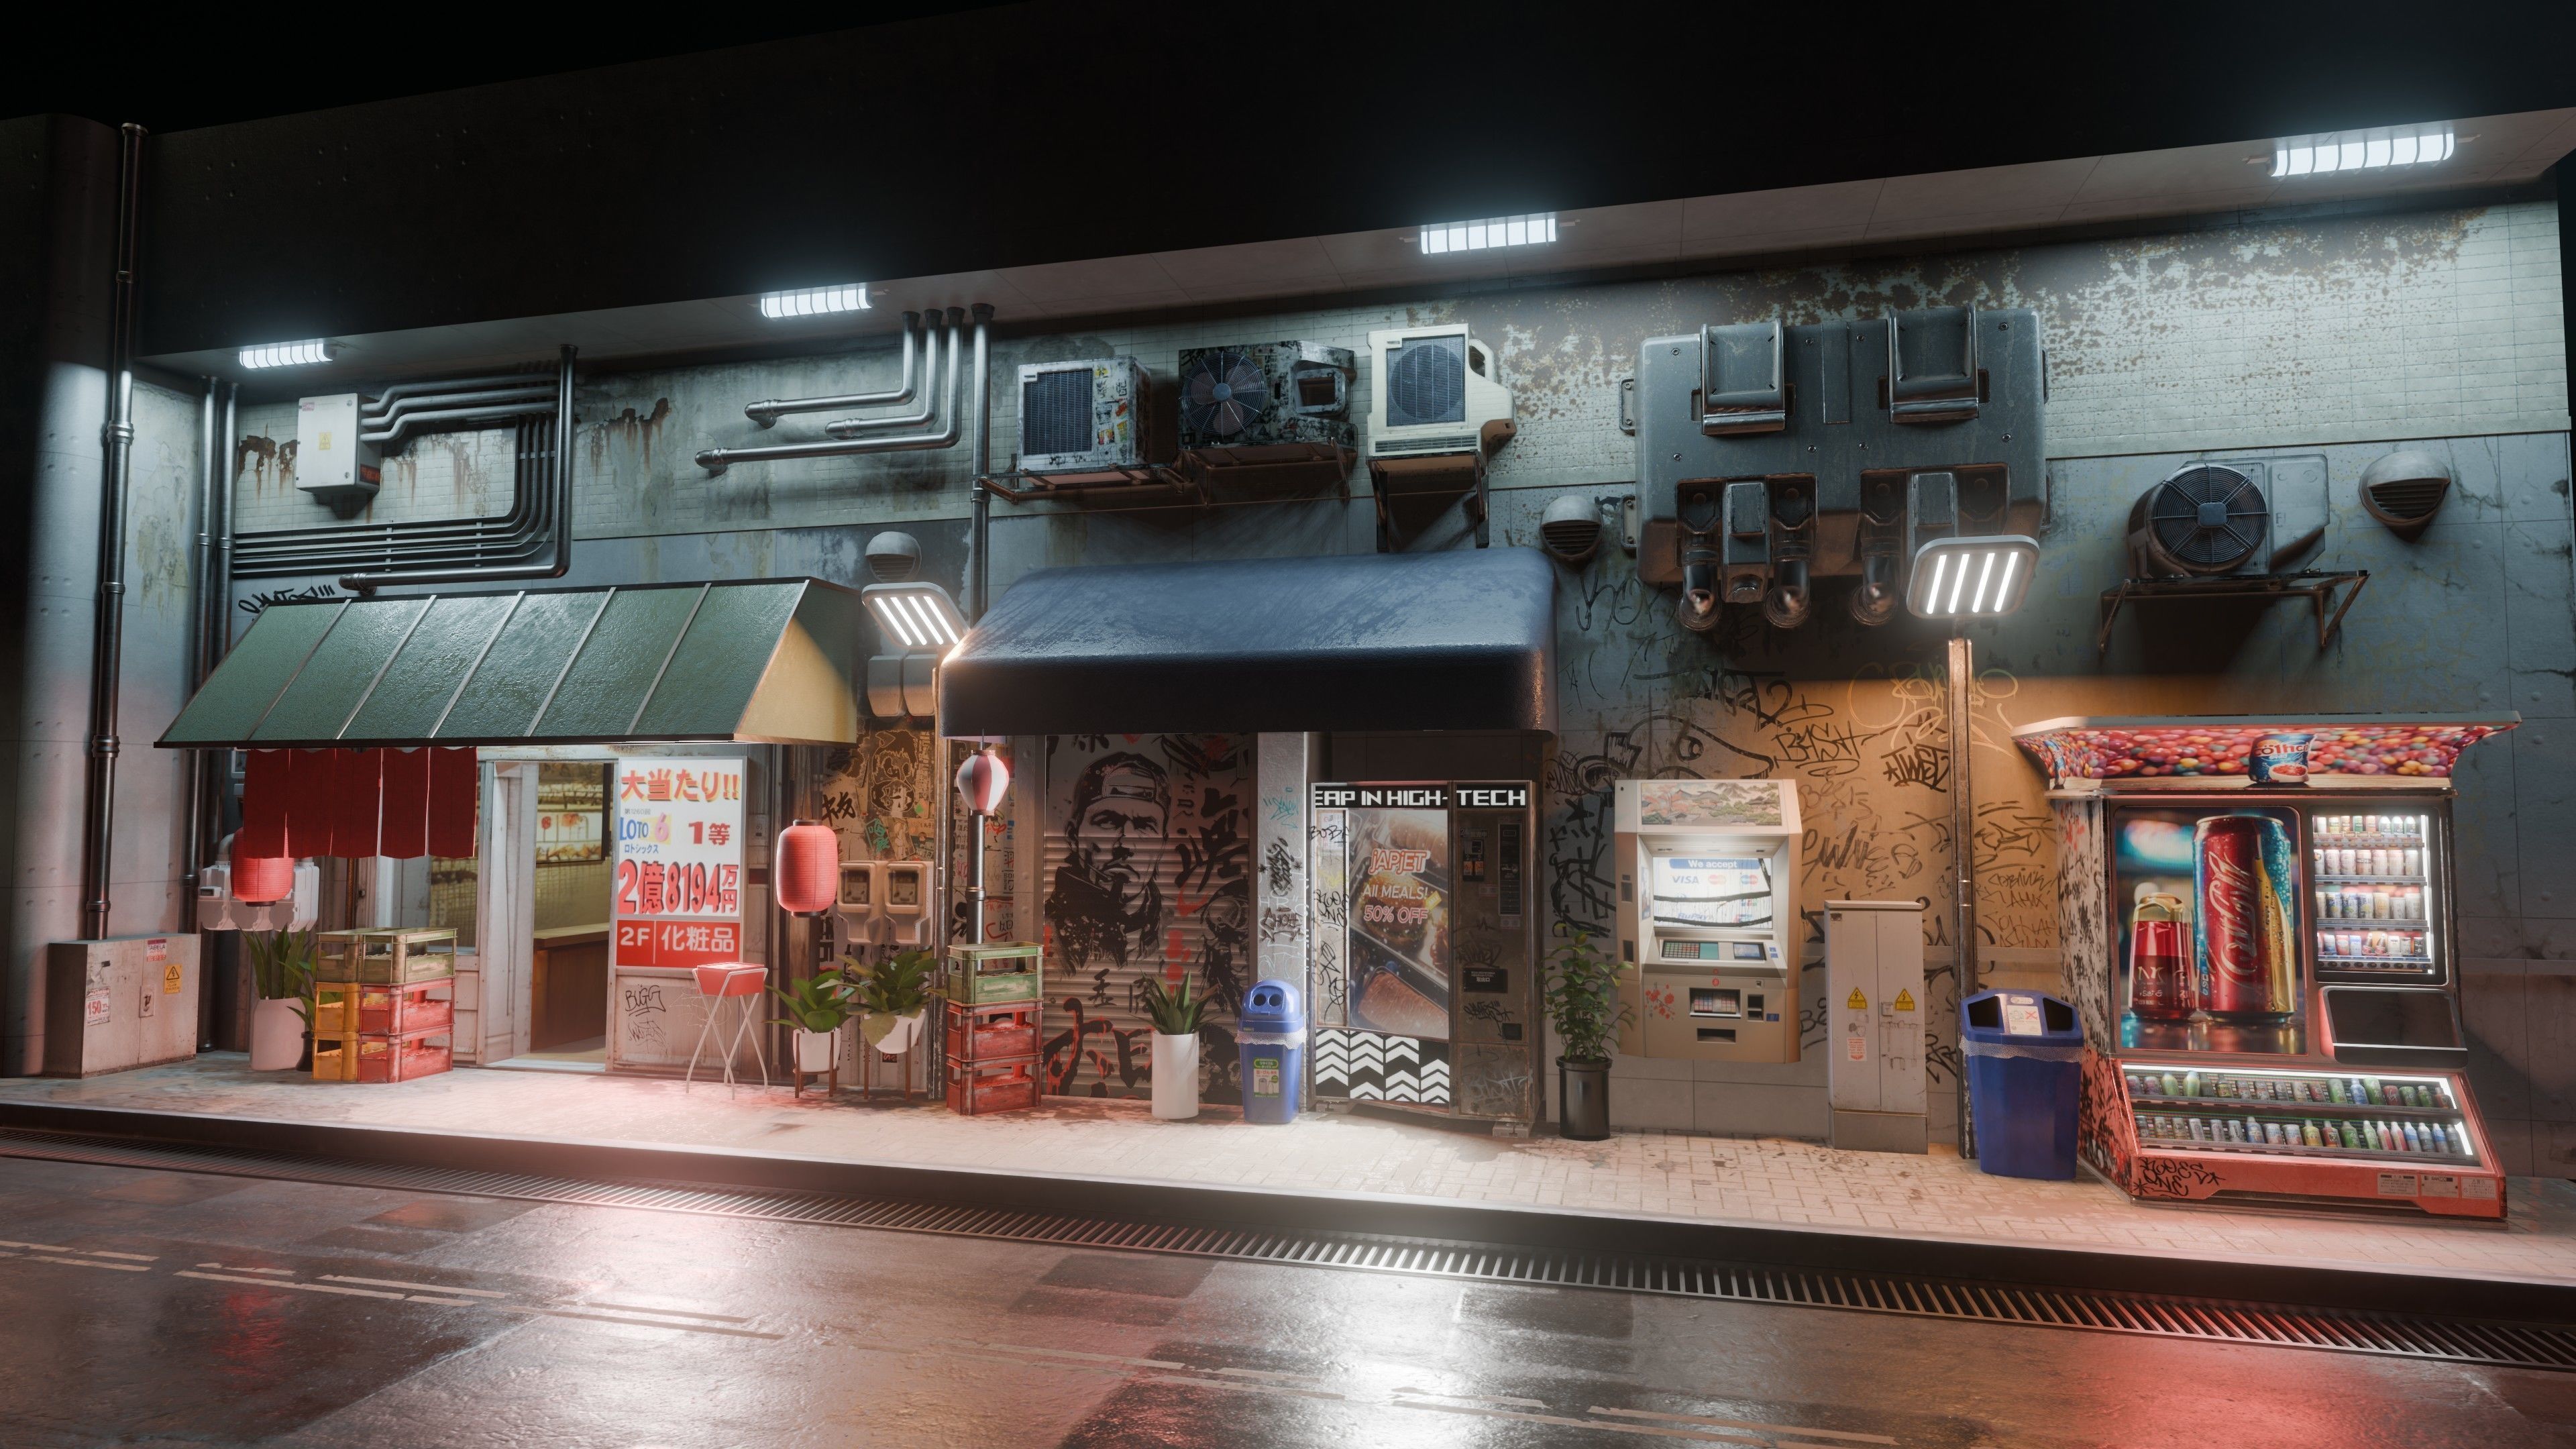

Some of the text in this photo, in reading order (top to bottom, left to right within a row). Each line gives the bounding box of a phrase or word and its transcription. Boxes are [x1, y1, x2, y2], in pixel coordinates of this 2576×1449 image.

[1361, 790, 1381, 806] IN
[620, 812, 669, 843] LOTO 6
[624, 843, 659, 854] ロトシックス
[1688, 860, 1738, 870] We accept
[1672, 875, 1699, 884] VISA
[1381, 885, 1428, 900] MEALS!
[1364, 906, 1394, 923] 50%
[1397, 907, 1430, 924] OFF
[621, 927, 650, 947] 2F
[661, 924, 735, 953] 化粧品
[87, 1001, 101, 1016] 150
